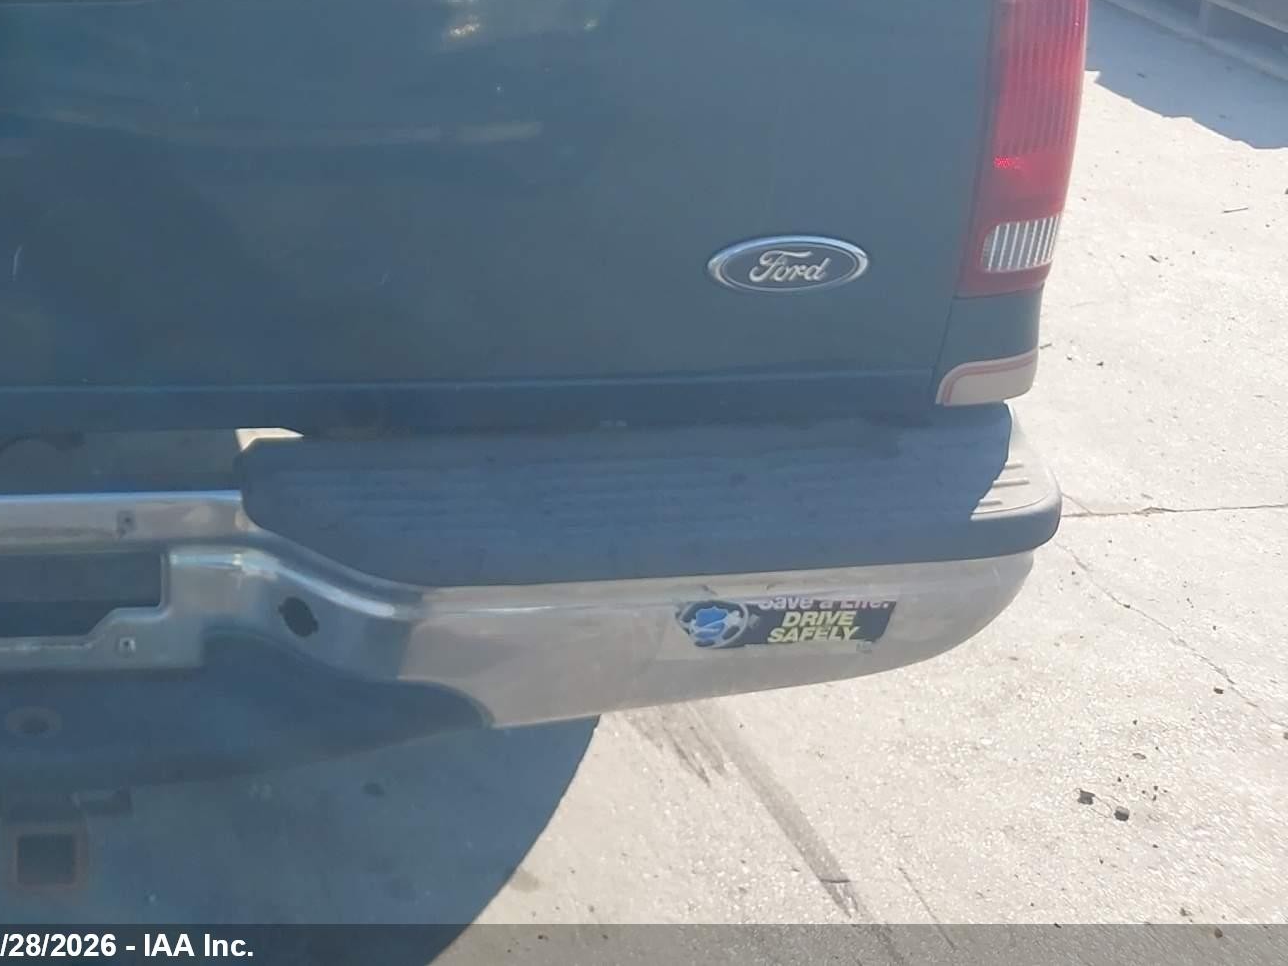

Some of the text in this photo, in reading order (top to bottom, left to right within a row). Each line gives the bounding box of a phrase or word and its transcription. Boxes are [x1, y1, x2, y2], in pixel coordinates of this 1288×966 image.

[749, 250, 831, 282] Ford
[782, 610, 858, 627] DRIVE
[767, 626, 860, 643] SAFELY
